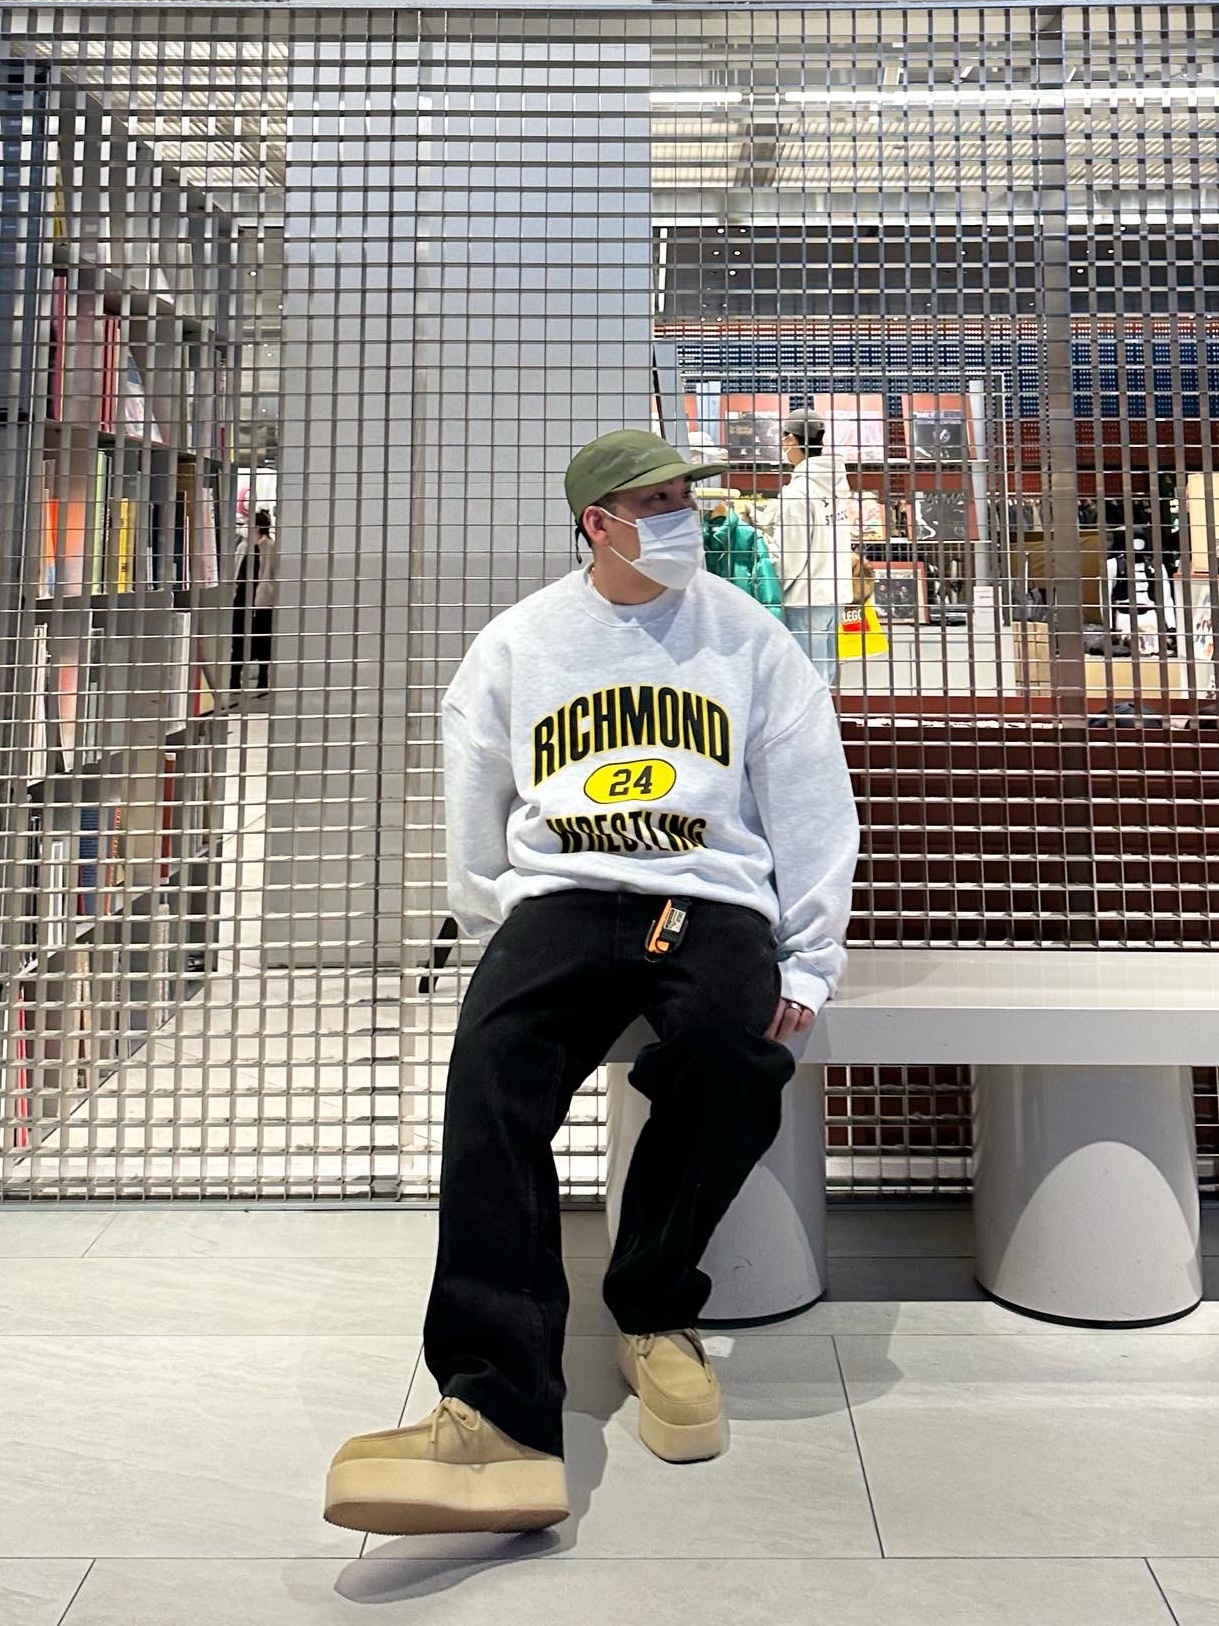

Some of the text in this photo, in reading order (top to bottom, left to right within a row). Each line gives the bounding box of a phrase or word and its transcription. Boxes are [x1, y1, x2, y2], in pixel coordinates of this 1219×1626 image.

[532, 684, 732, 788] RICHMOND
[609, 765, 653, 797] 24
[545, 810, 708, 854] WRESTLING
